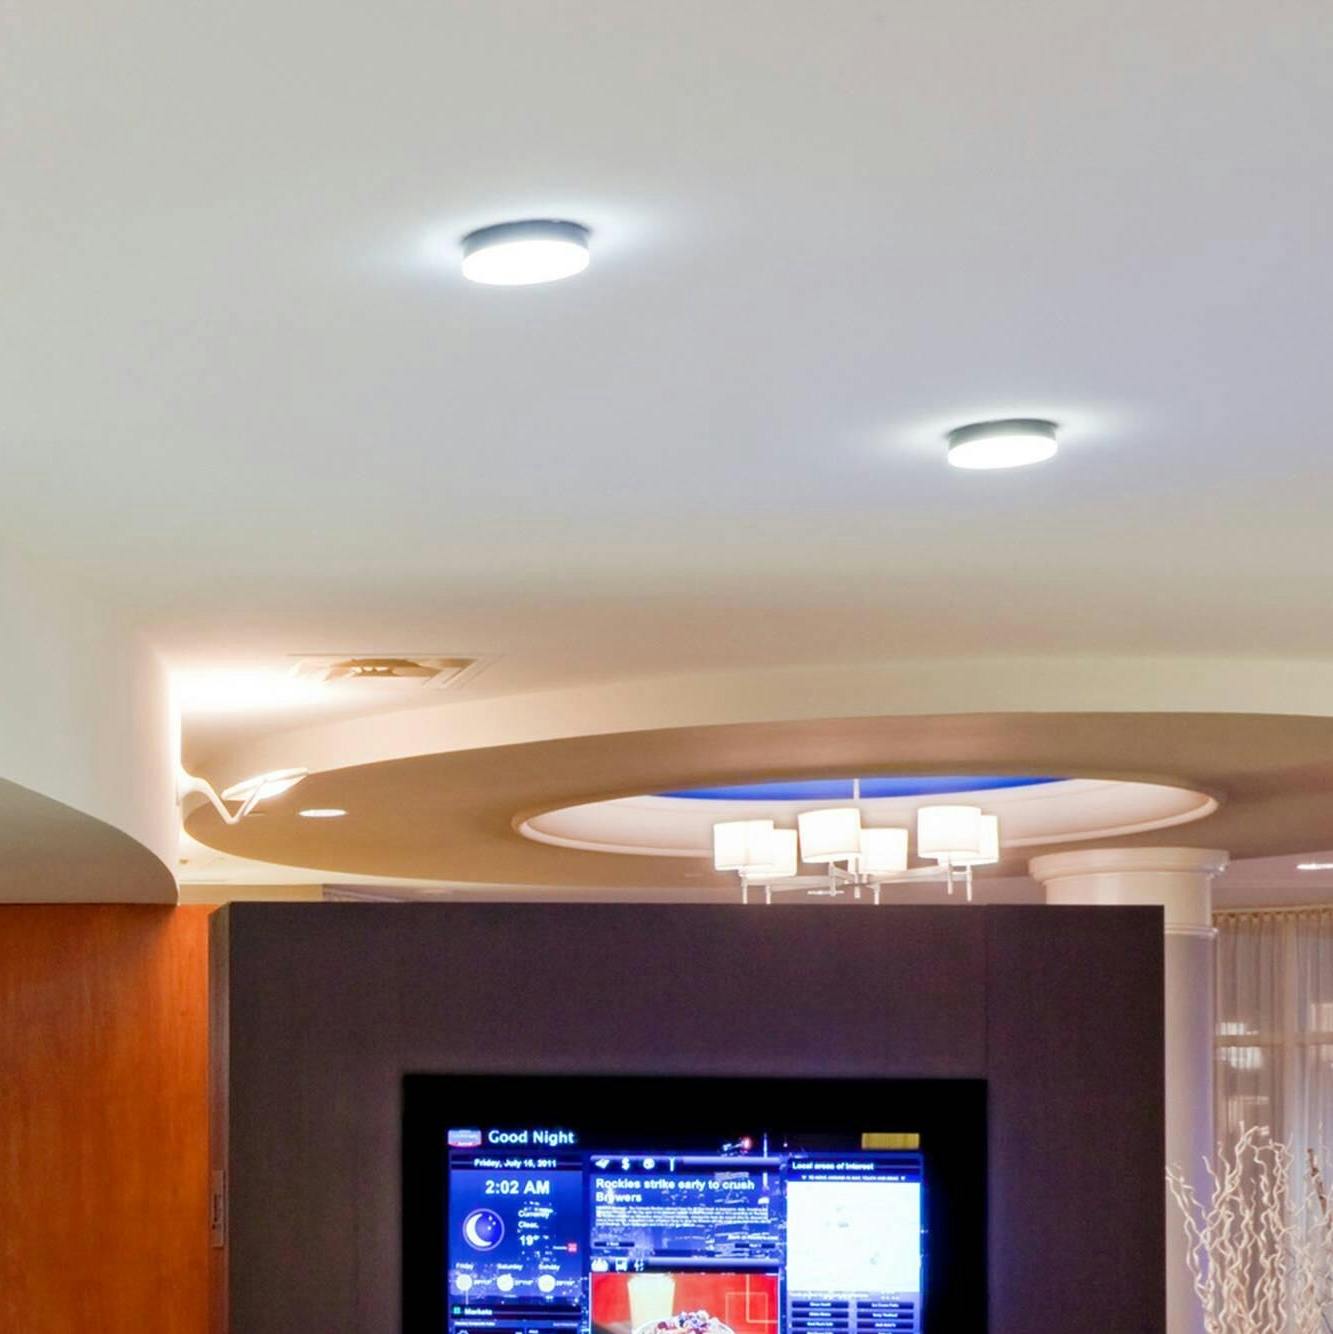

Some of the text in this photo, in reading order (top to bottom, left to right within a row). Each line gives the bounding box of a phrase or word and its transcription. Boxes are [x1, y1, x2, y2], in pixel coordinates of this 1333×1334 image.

[488, 1130, 528, 1144] Good
[533, 1130, 575, 1146] Night
[504, 1159, 521, 1168] July
[537, 1159, 557, 1168] 2011
[792, 1162, 813, 1170] Local
[836, 1162, 844, 1170] of
[485, 1180, 550, 1194] 2:02 AM
[596, 1178, 755, 1192] Rockies strike early to crush
